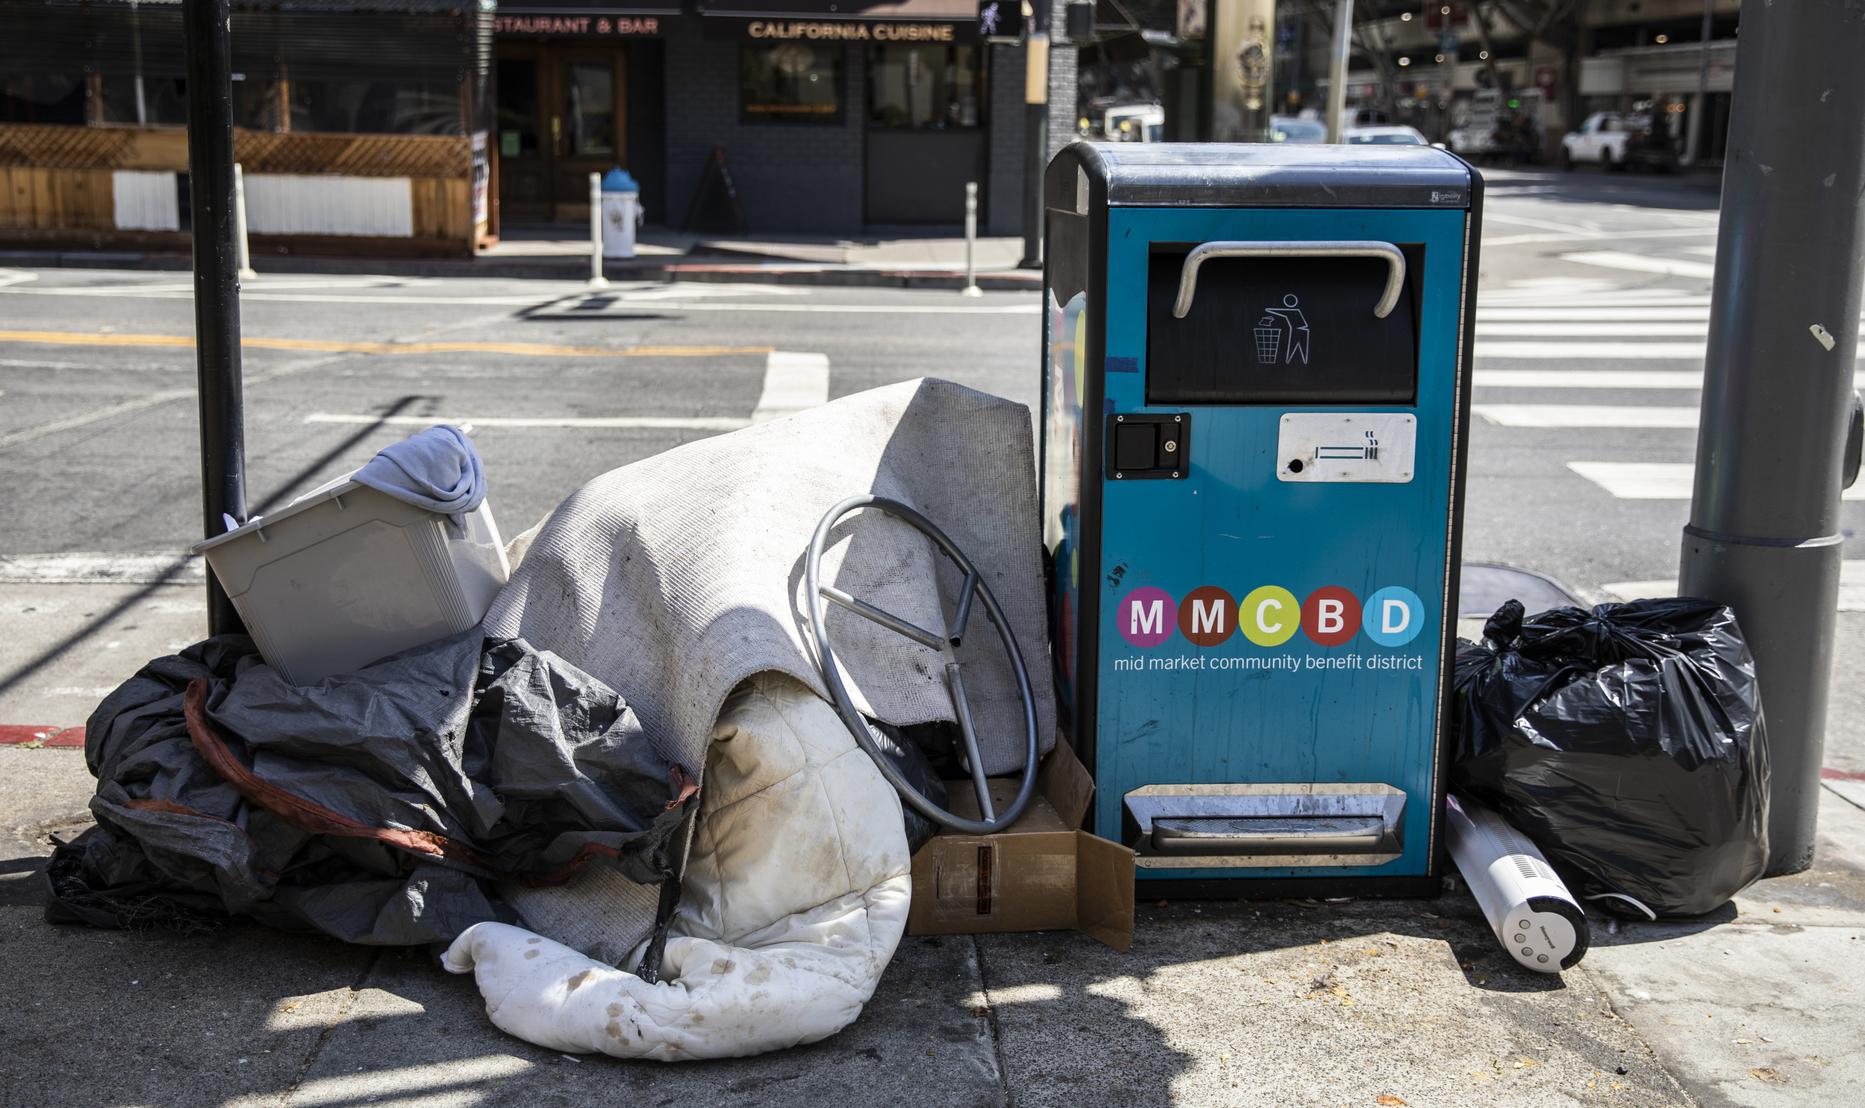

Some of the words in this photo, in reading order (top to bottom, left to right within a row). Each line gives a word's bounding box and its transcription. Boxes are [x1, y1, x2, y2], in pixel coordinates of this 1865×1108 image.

[618, 18, 658, 34] BAR
[748, 21, 869, 40] CALIFORNIA
[872, 23, 954, 41] CUISINE
[1114, 655, 1144, 671] mid
[1148, 655, 1206, 671] market
[1209, 653, 1301, 673] community
[1305, 654, 1362, 670] benefit
[1366, 654, 1423, 670] district
